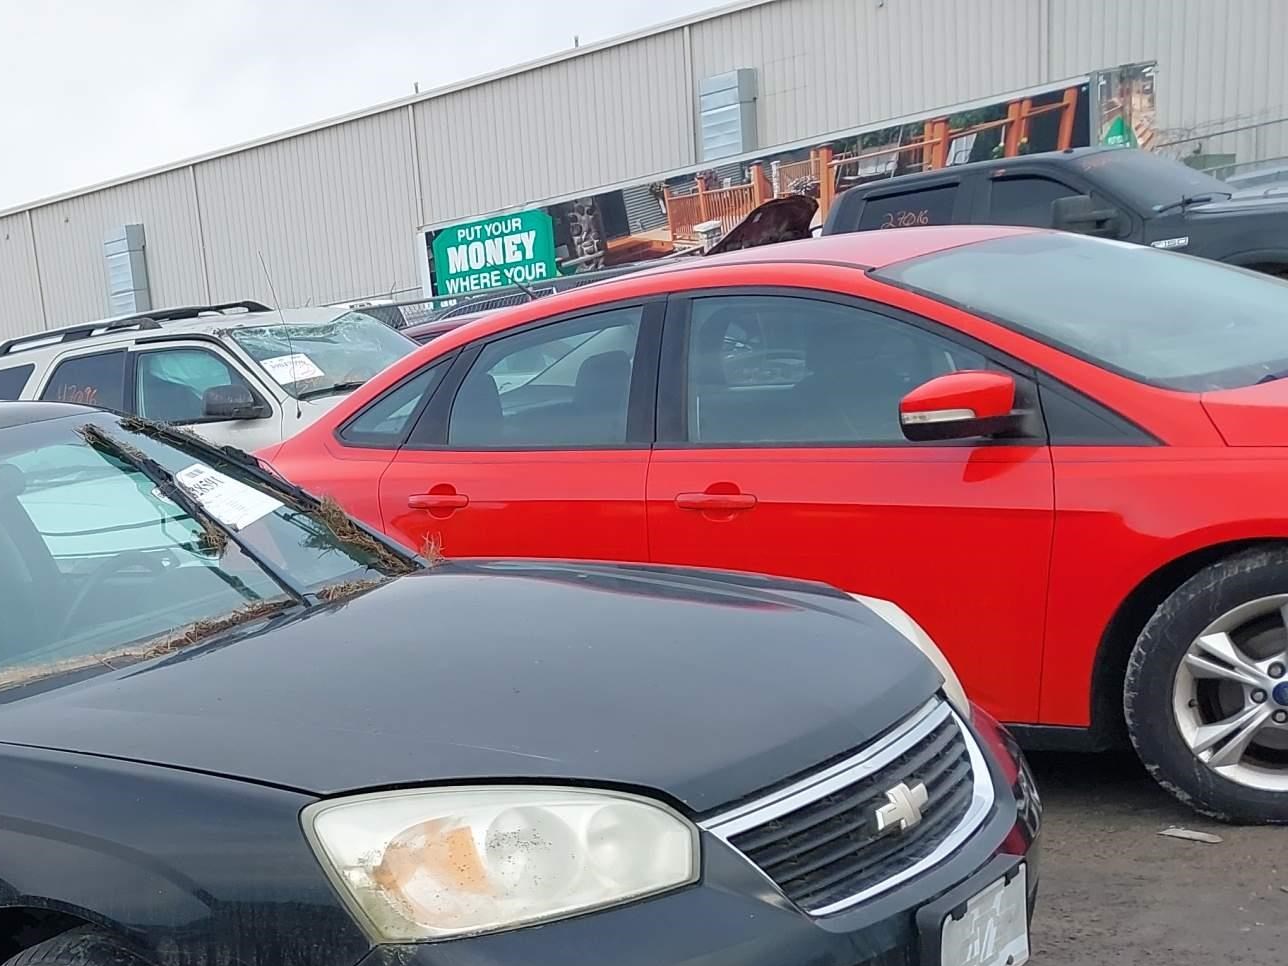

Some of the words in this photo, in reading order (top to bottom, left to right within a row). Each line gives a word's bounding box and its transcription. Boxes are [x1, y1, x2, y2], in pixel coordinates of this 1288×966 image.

[457, 225, 482, 242] PUT
[484, 217, 522, 237] YOUR
[446, 230, 536, 274] MONEY
[445, 270, 502, 295] WHERE
[504, 262, 547, 284] YOUR
